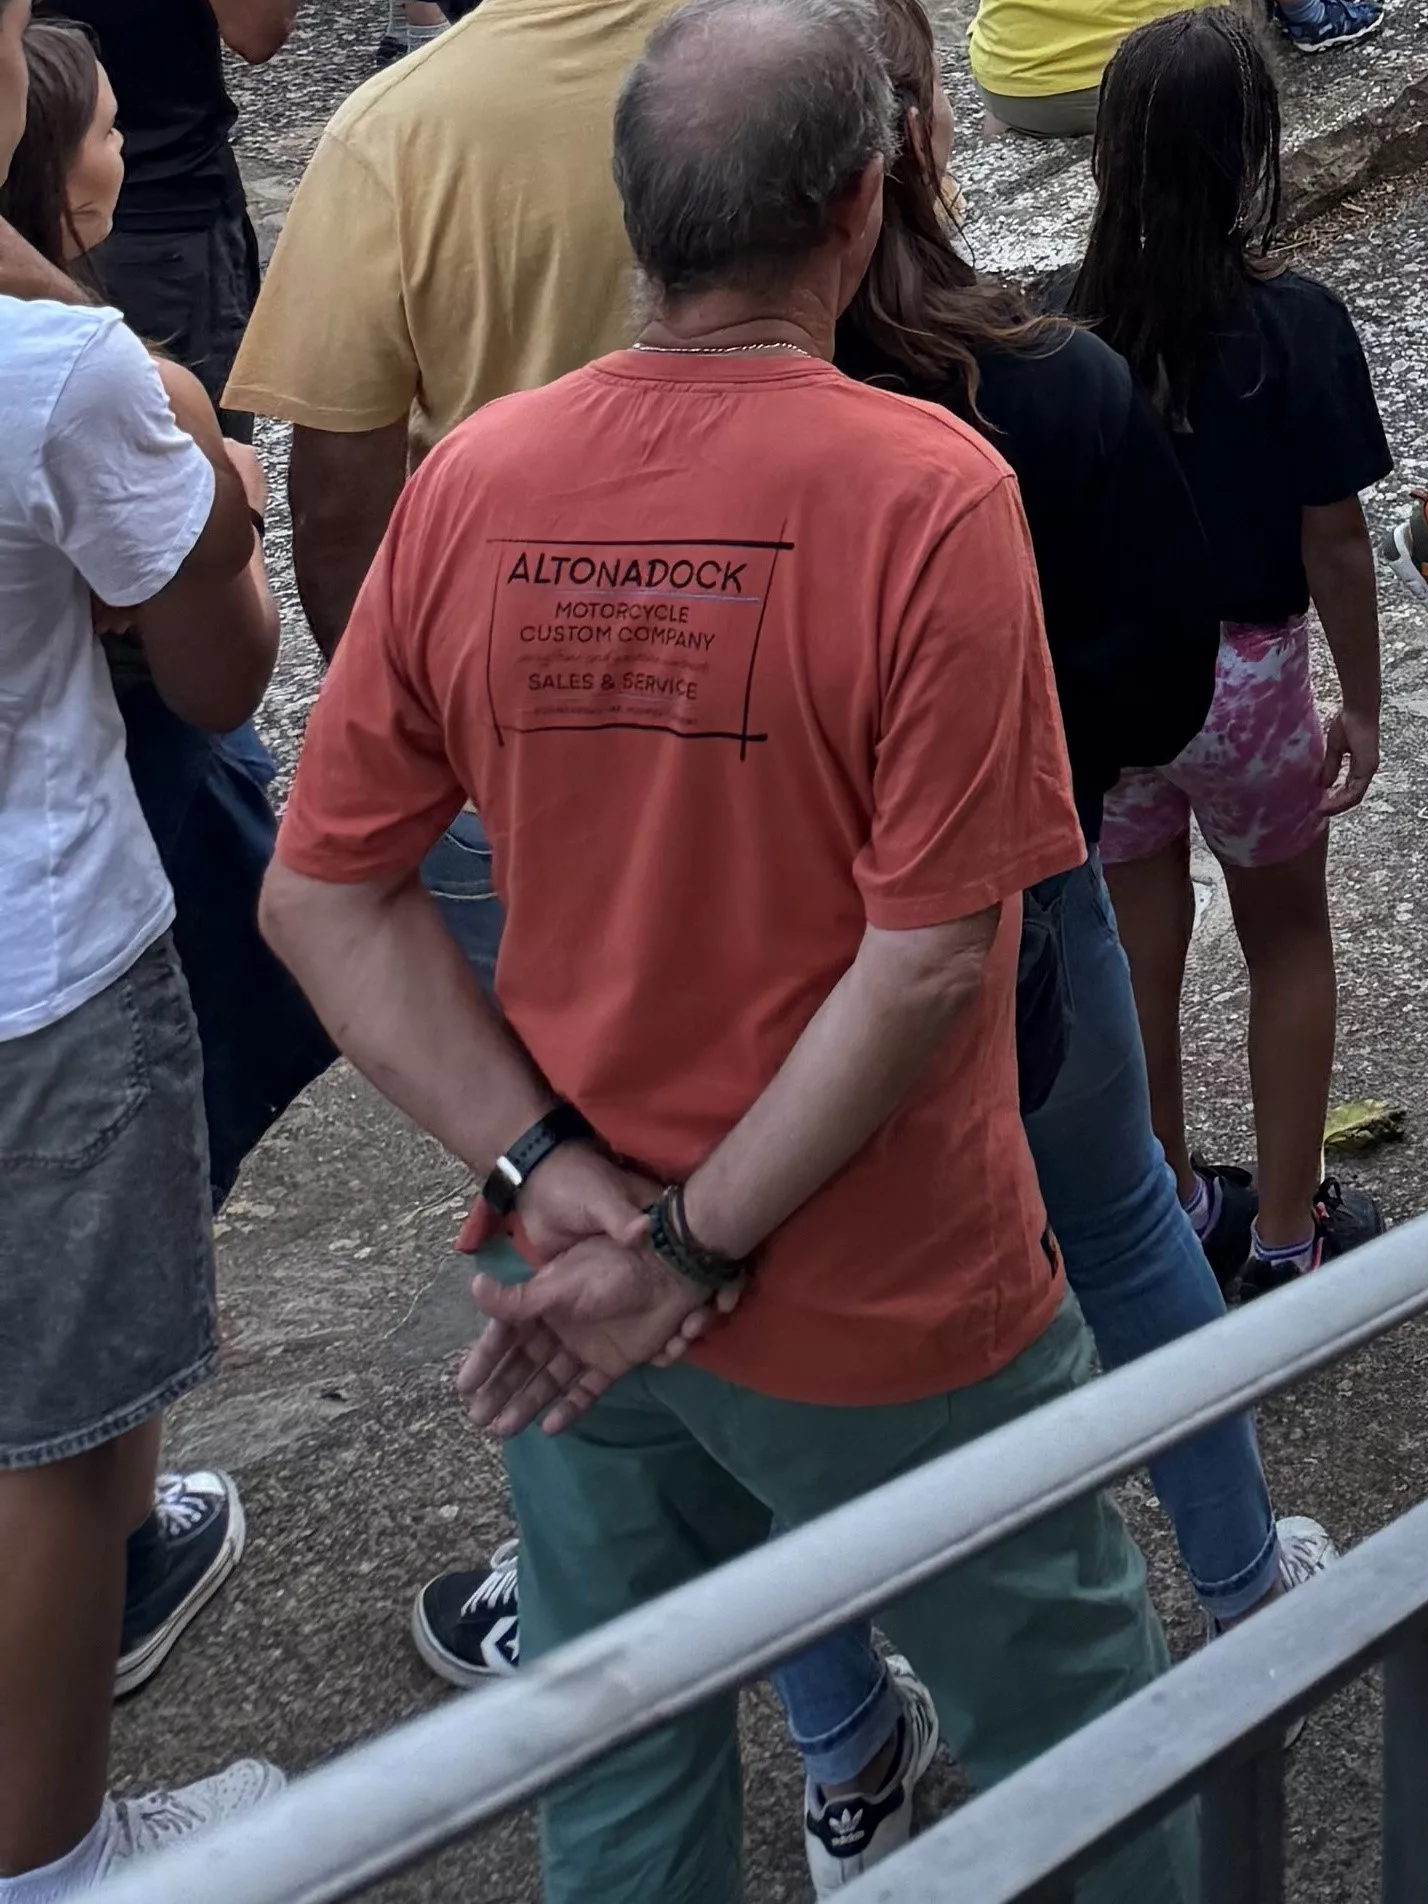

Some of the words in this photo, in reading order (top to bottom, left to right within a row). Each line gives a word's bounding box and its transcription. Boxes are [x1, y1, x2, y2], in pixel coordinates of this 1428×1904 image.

[507, 552, 747, 593] ALTONADOCK
[555, 602, 690, 624] MOTORCYCLE
[520, 625, 612, 643] CUSTOM
[618, 626, 716, 651] COMPANY
[528, 673, 594, 691] SALES
[601, 673, 615, 691] &
[622, 672, 698, 700] SERVICE
